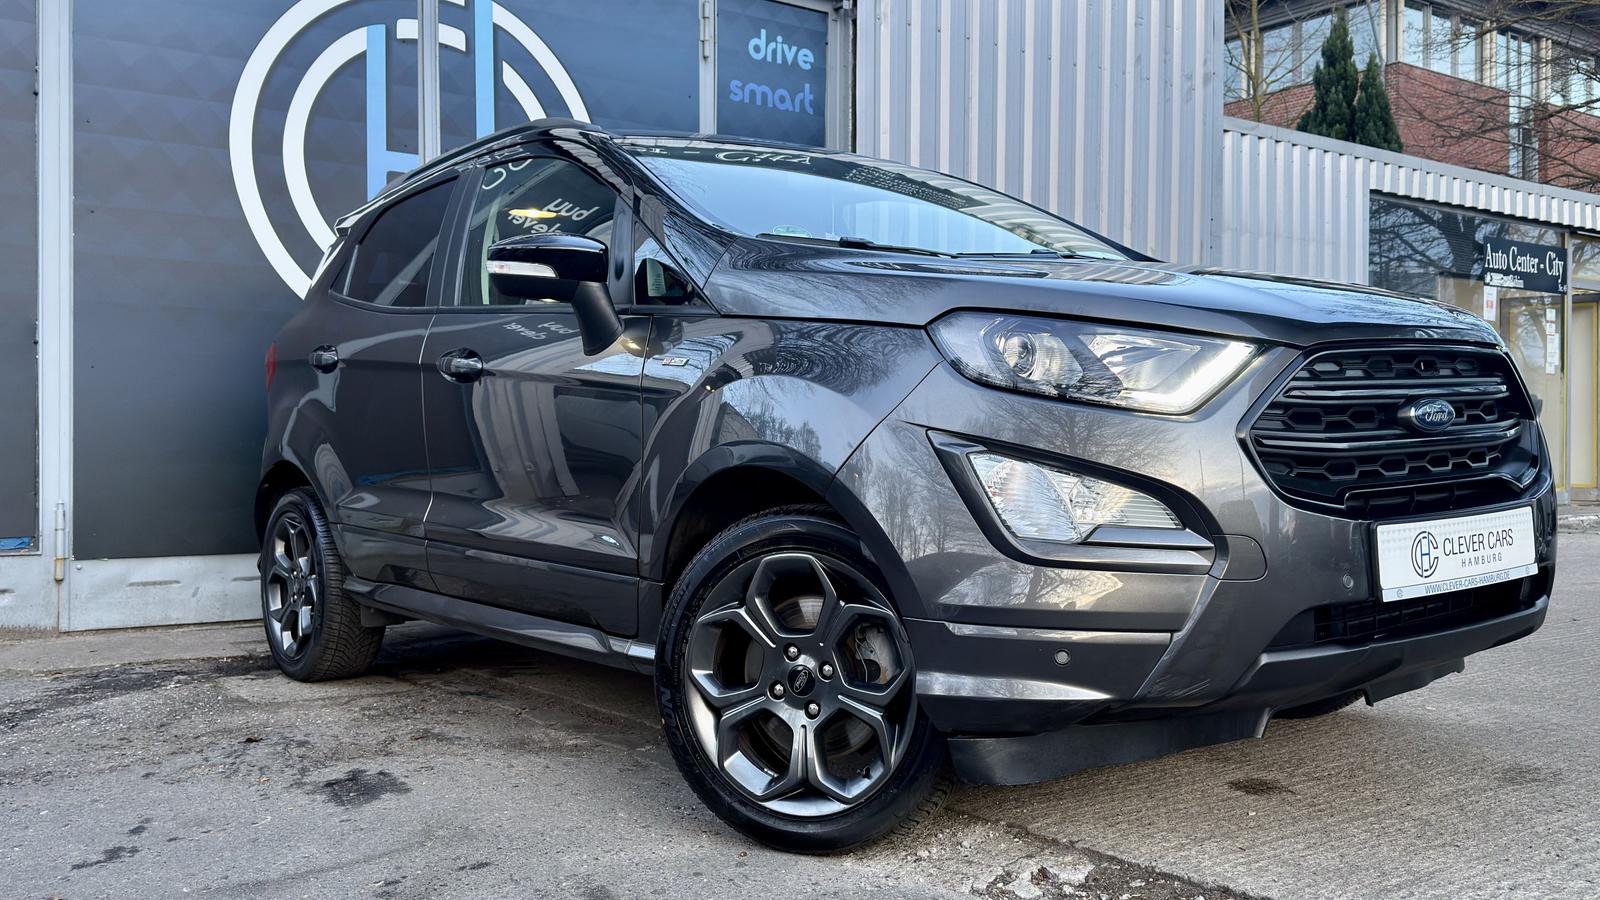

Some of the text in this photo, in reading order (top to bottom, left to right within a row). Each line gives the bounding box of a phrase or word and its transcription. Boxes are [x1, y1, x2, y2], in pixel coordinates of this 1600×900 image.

[748, 28, 814, 70] drive
[729, 79, 814, 115] smart
[1484, 242, 1508, 271] Auto
[1509, 246, 1539, 274] Center
[1546, 250, 1564, 283] City
[1425, 404, 1449, 422] Ford
[1443, 528, 1514, 557] CLEVER CARS
[1461, 552, 1503, 568] HAMBURG
[1424, 570, 1511, 595] WWW.CLEVER-CARS-HAMBURG.DE
